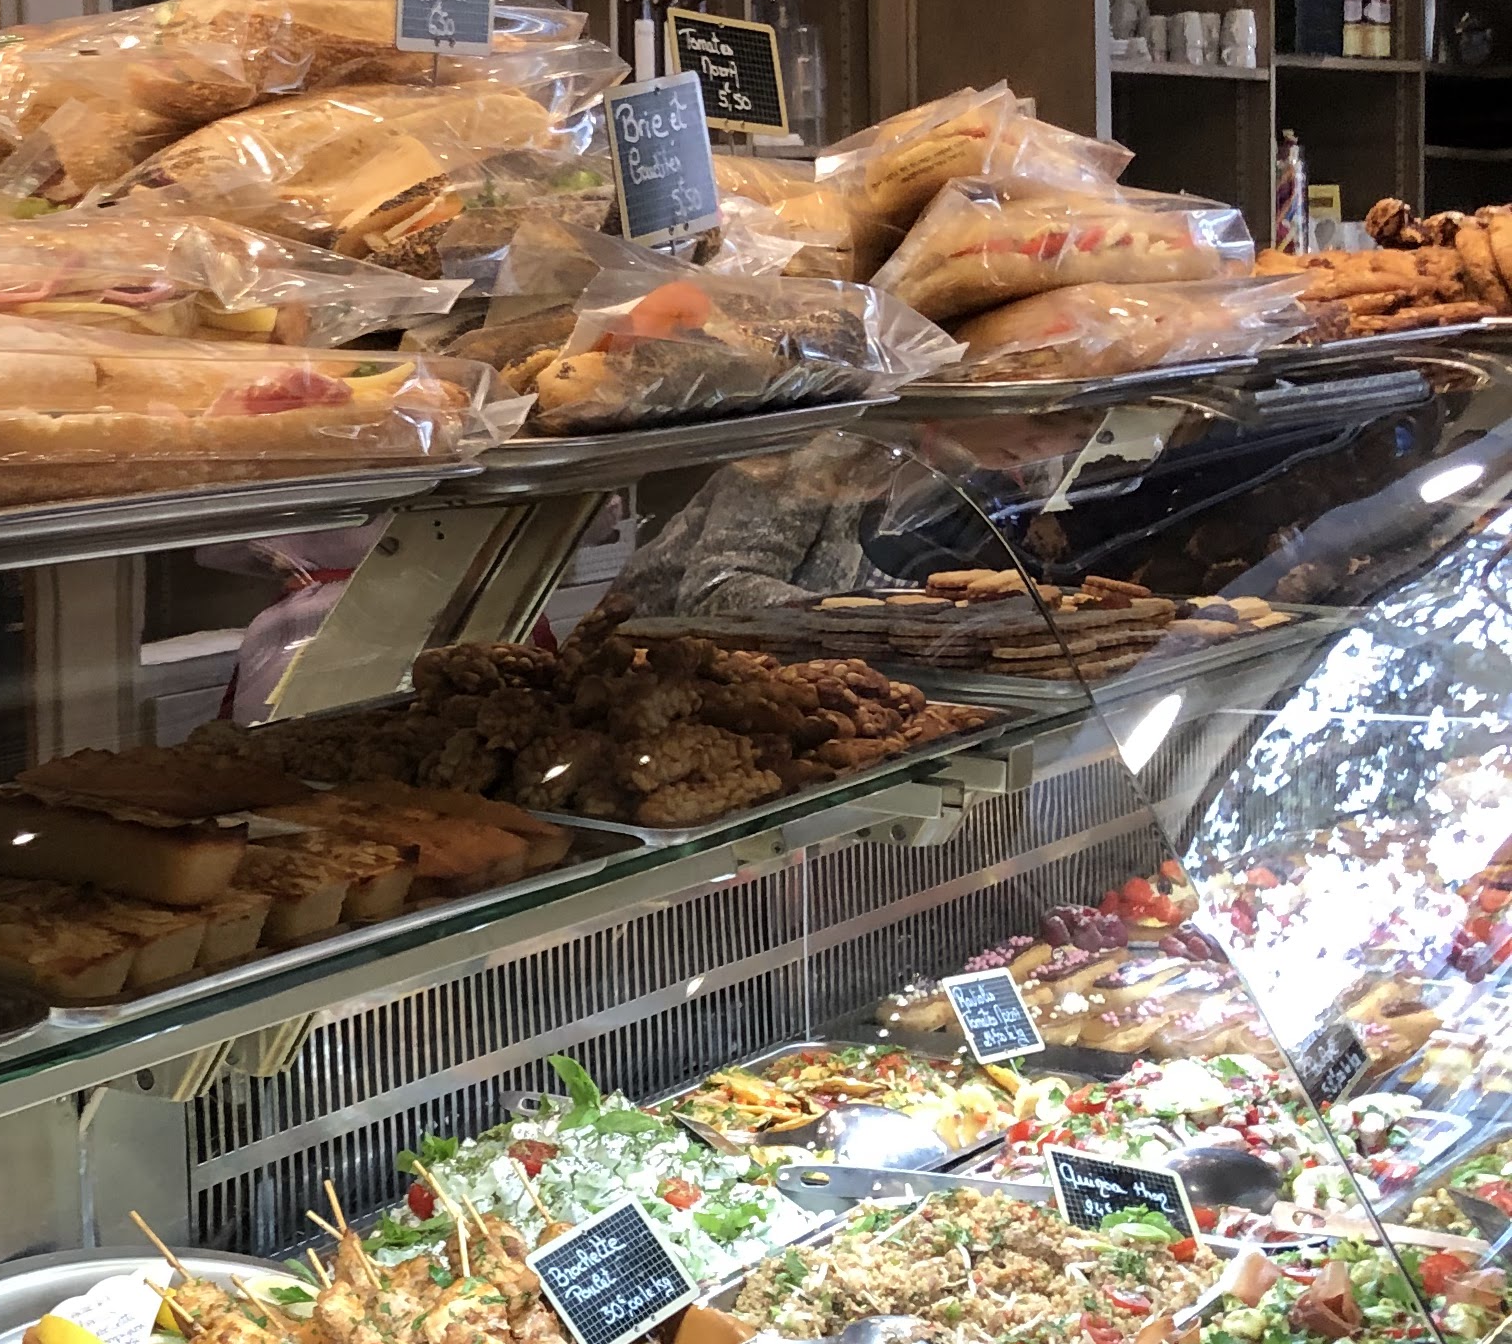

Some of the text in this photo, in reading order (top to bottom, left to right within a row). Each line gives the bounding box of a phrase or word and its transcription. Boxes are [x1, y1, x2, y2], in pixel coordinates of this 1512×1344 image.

[615, 103, 669, 143] Brie
[547, 1235, 626, 1287] Brochette
[565, 1269, 617, 1303] Poulet
[655, 1277, 675, 1298] kg
